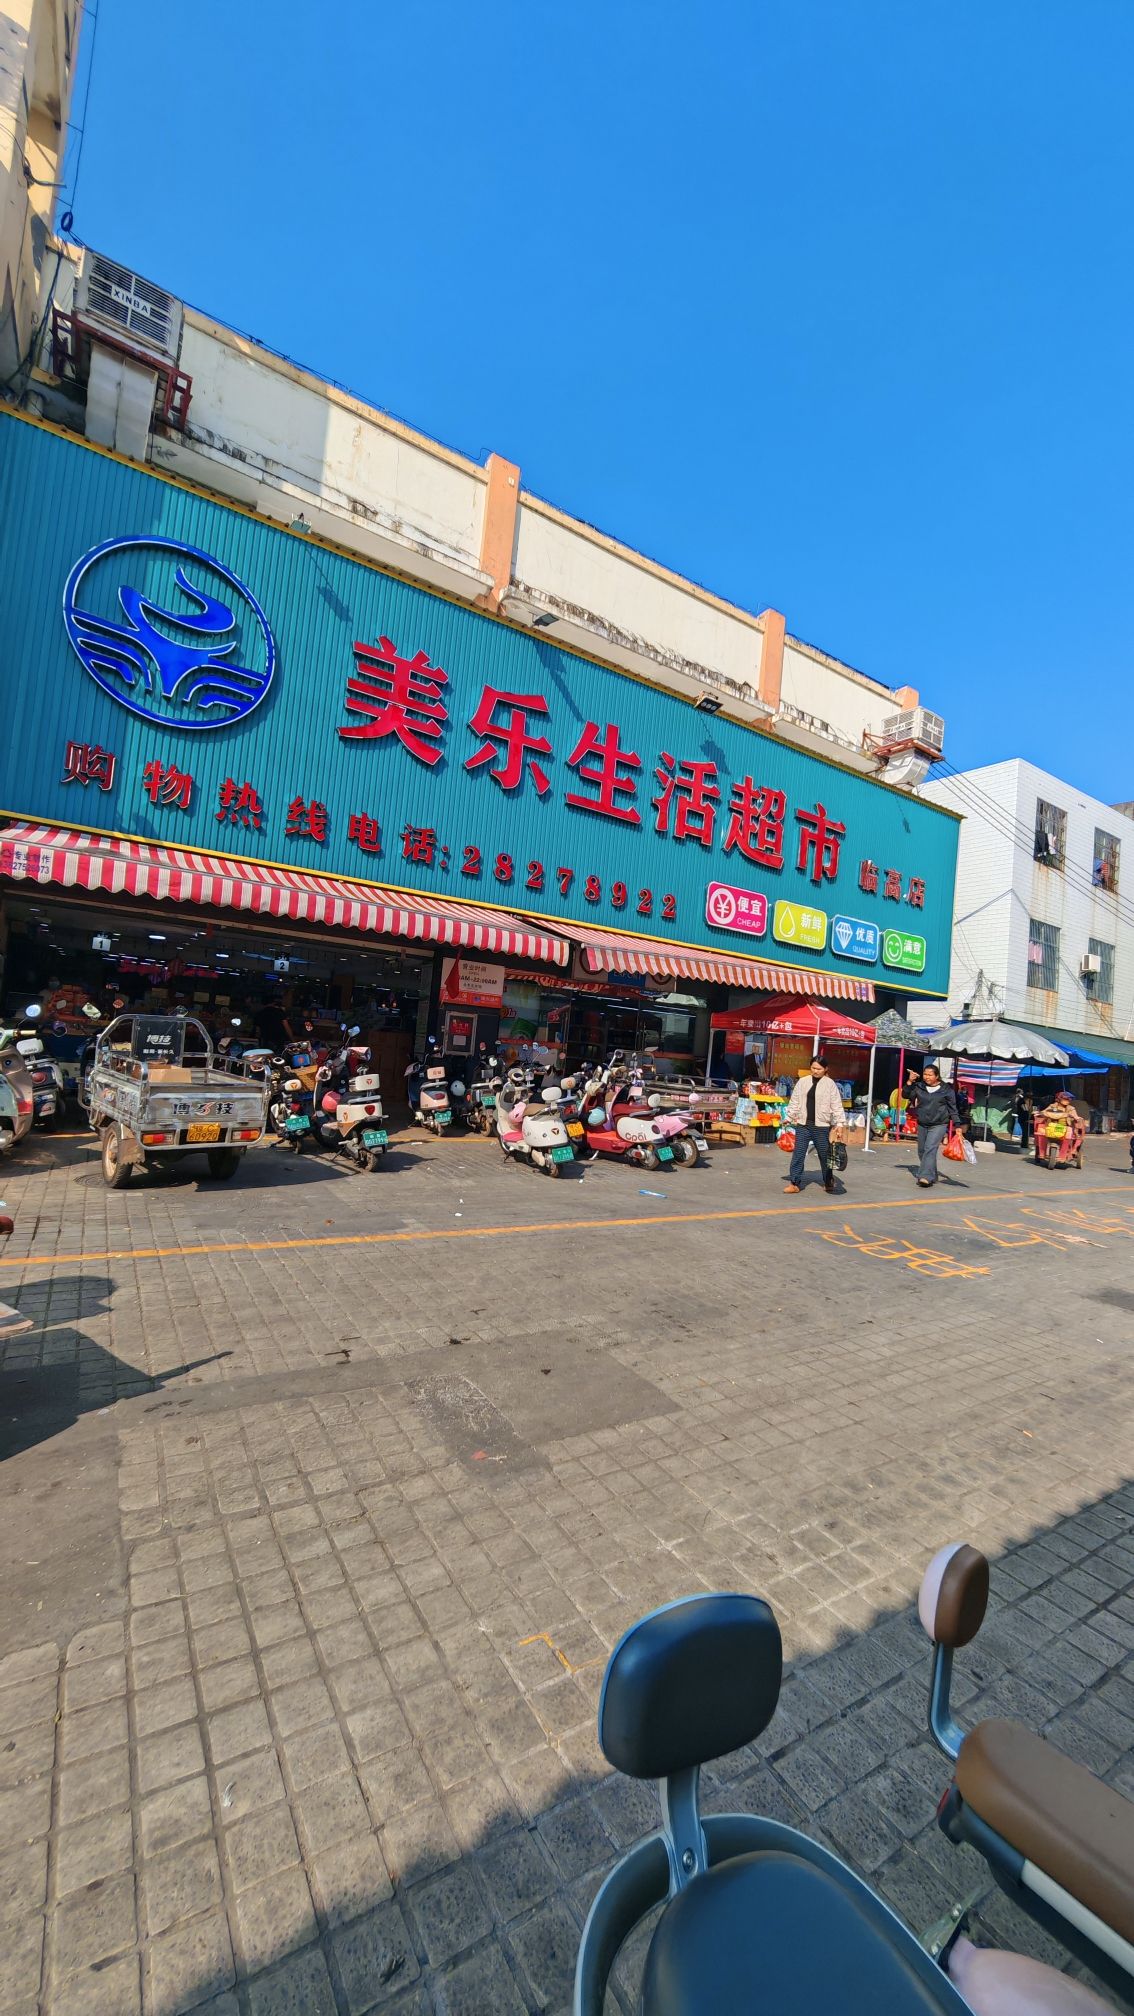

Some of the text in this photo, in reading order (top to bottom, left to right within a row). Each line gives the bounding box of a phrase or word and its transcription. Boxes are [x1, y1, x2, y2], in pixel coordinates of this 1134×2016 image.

[113, 288, 149, 314] XINBA
[337, 635, 846, 882] 美乐生活超市
[859, 860, 926, 907] 临高店
[737, 896, 762, 916] 便宜
[736, 917, 761, 929] CHEAP
[801, 913, 822, 932] 新鲜
[800, 933, 820, 945] FRESH
[855, 927, 875, 945] 优质
[852, 945, 875, 956] QUALITY
[903, 939, 922, 955] 满意
